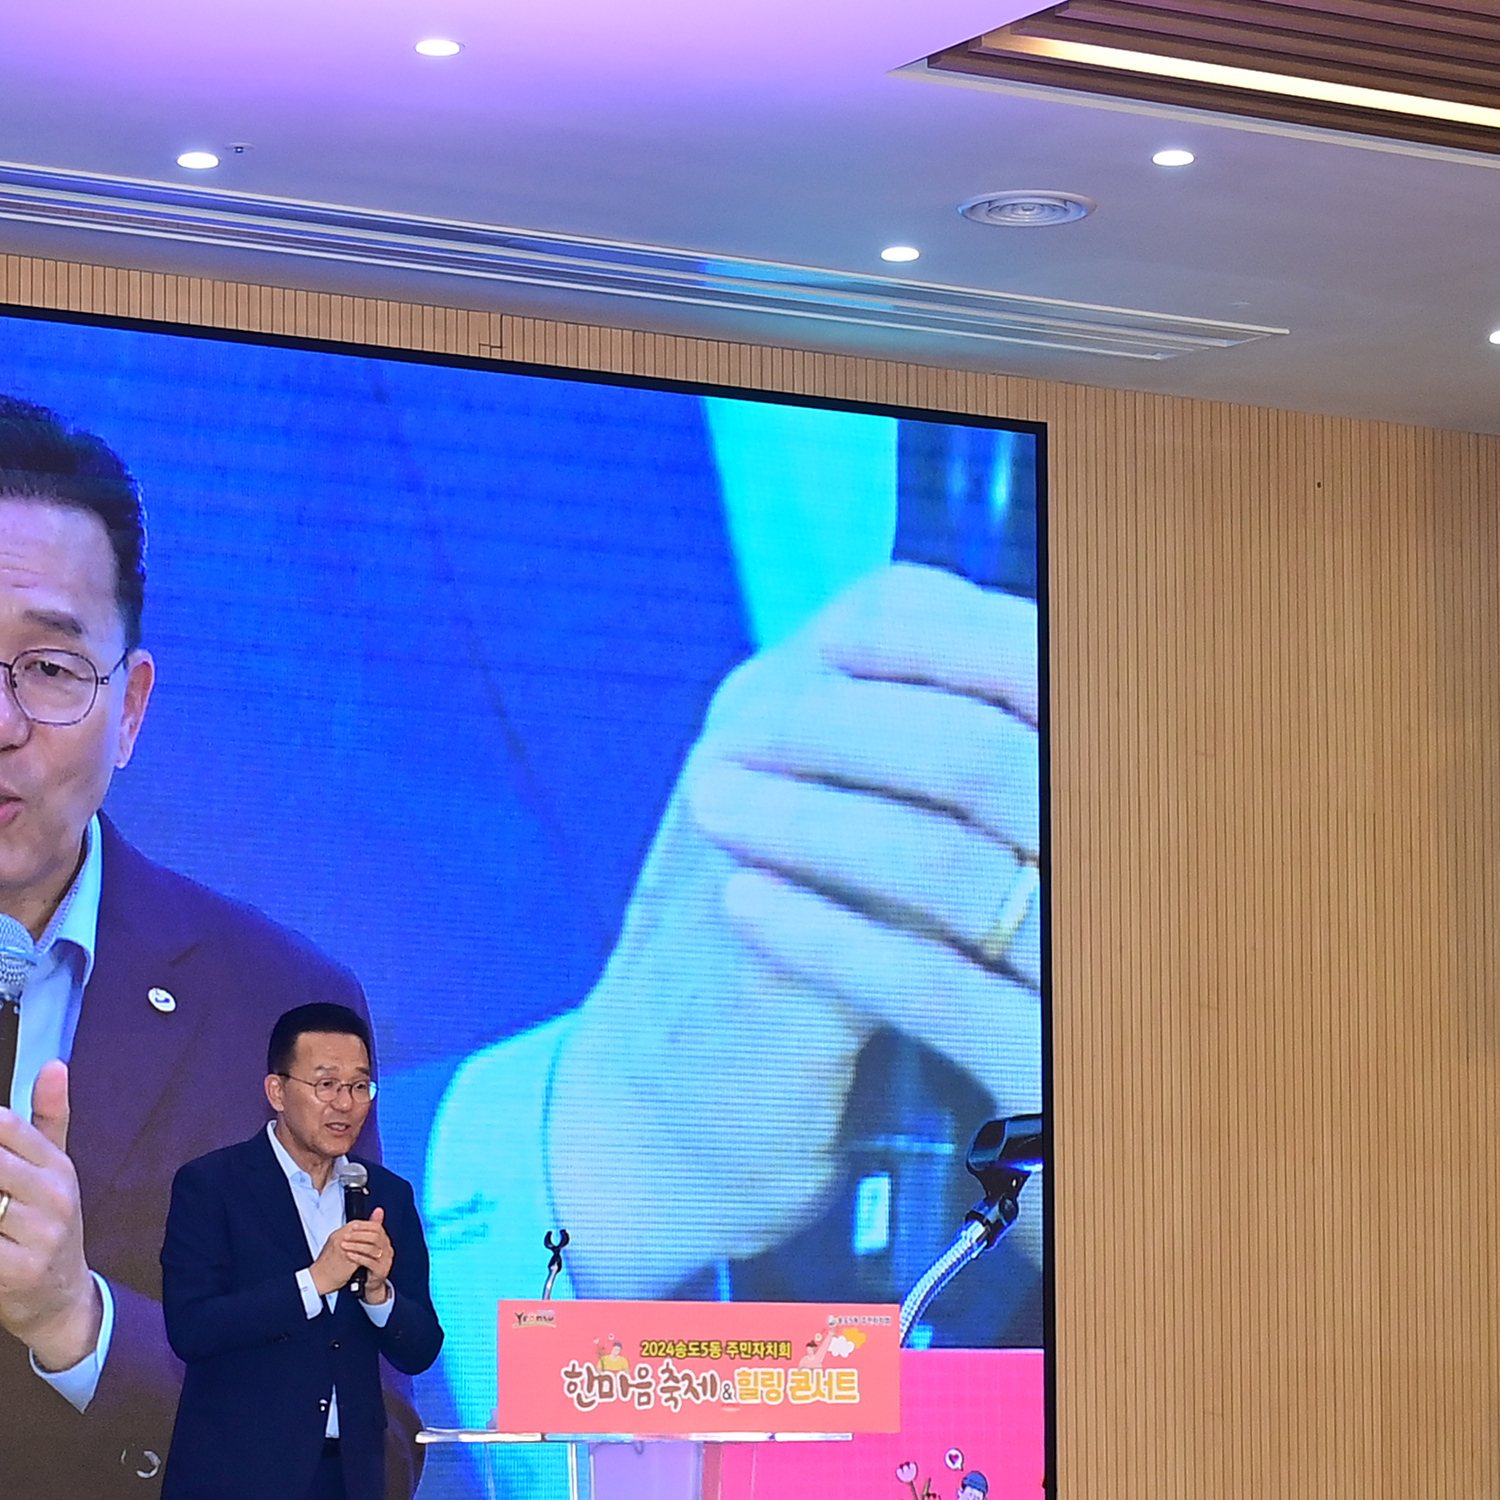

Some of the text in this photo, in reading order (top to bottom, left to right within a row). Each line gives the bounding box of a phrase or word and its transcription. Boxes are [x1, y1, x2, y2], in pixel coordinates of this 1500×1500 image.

[641, 1341, 792, 1359] 2024송도5동 주민자치회
[563, 1362, 653, 1409] 한마음
[660, 1361, 718, 1410] 축제
[736, 1370, 783, 1402] 힐링
[790, 1370, 858, 1401] 콘서트
